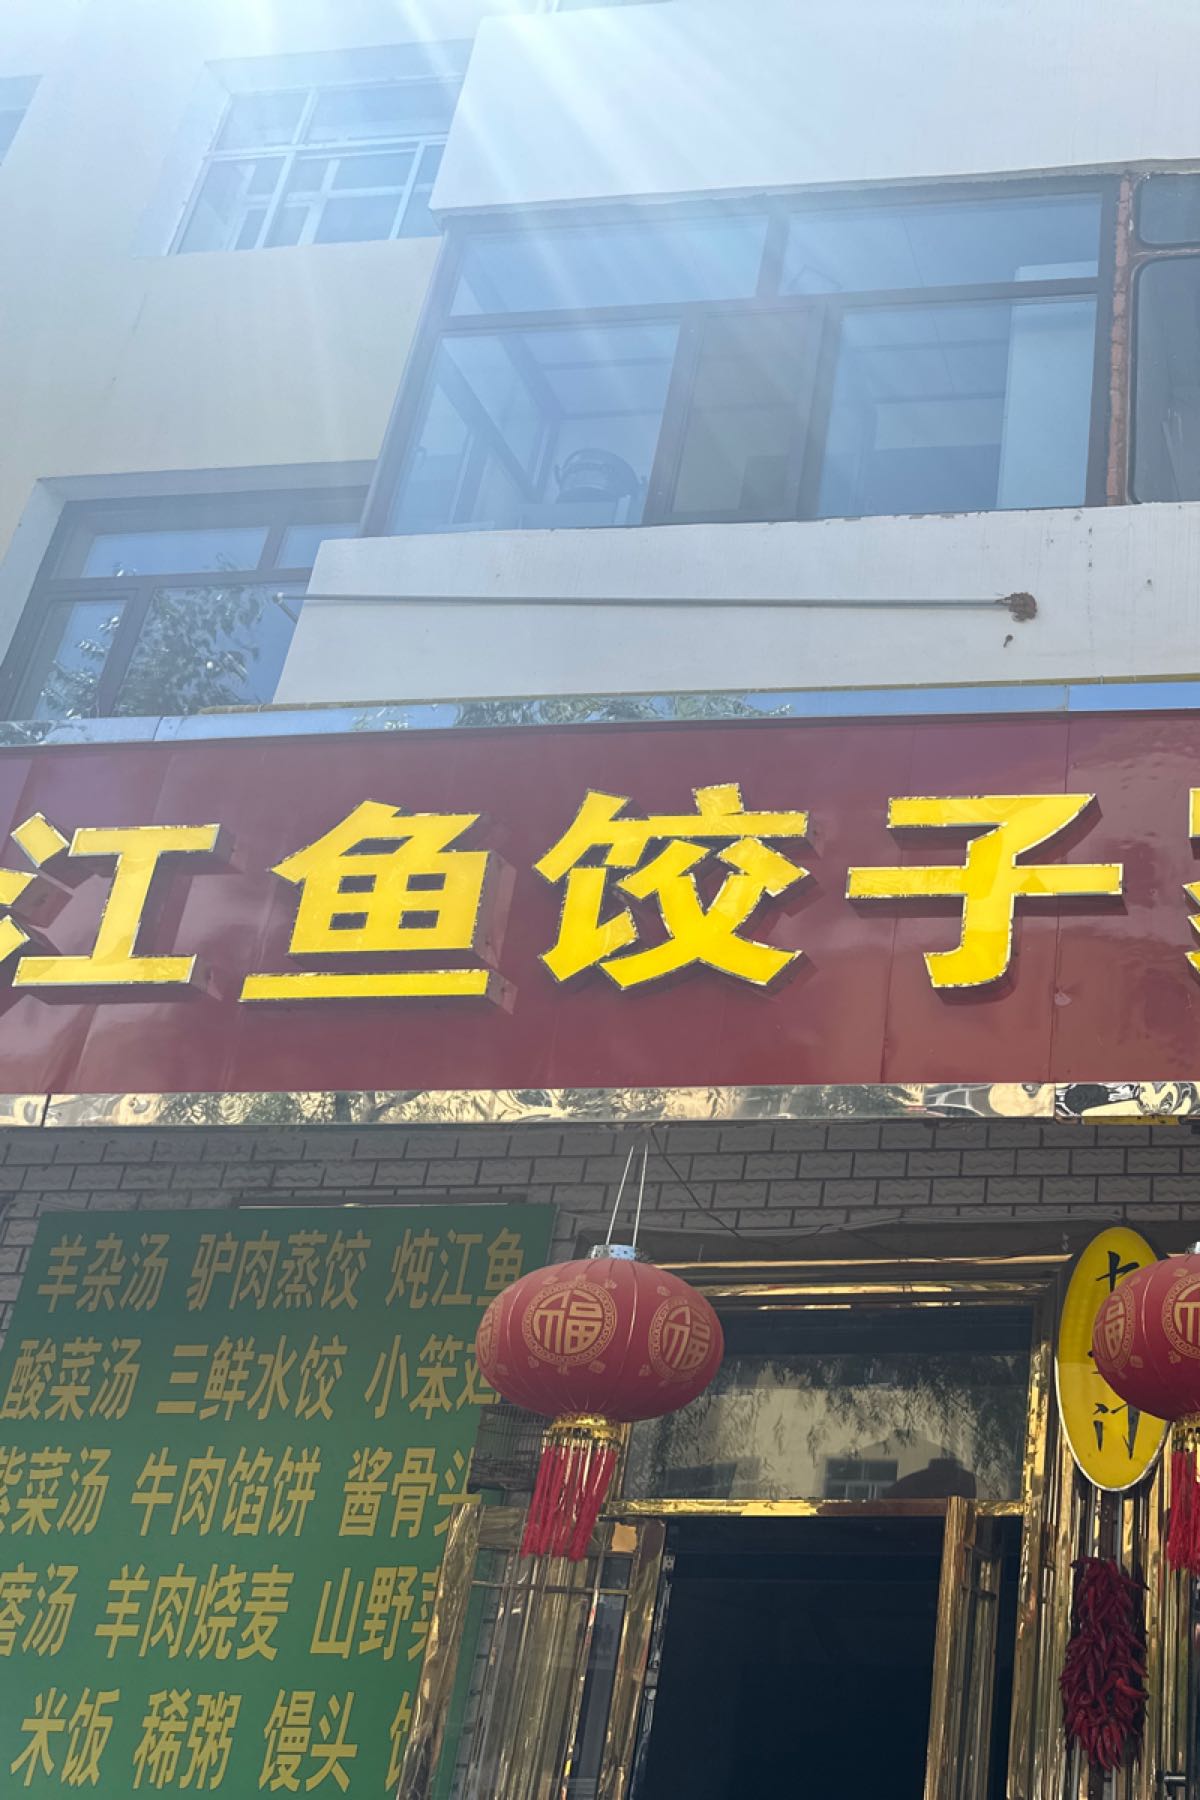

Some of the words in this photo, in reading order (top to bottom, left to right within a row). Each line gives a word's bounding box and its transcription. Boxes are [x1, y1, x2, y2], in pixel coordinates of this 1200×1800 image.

[38, 1232, 171, 1313] 羊杂汤
[186, 1228, 372, 1310] 驴肉蒸饺
[385, 1228, 525, 1309] 炖江鱼
[533, 1290, 602, 1354] 福
[662, 1305, 711, 1370] 福
[0, 1334, 142, 1421] 酸菜汤
[156, 1333, 347, 1422] 三鲜水饺
[131, 1445, 320, 1537] 牛肉馅饼
[338, 1446, 482, 1538] 酱骨头
[95, 1562, 294, 1660] 羊肉烧麦
[10, 1687, 119, 1788] 米饭
[131, 1688, 242, 1790] 稀粥
[258, 1688, 358, 1792] 馒头
